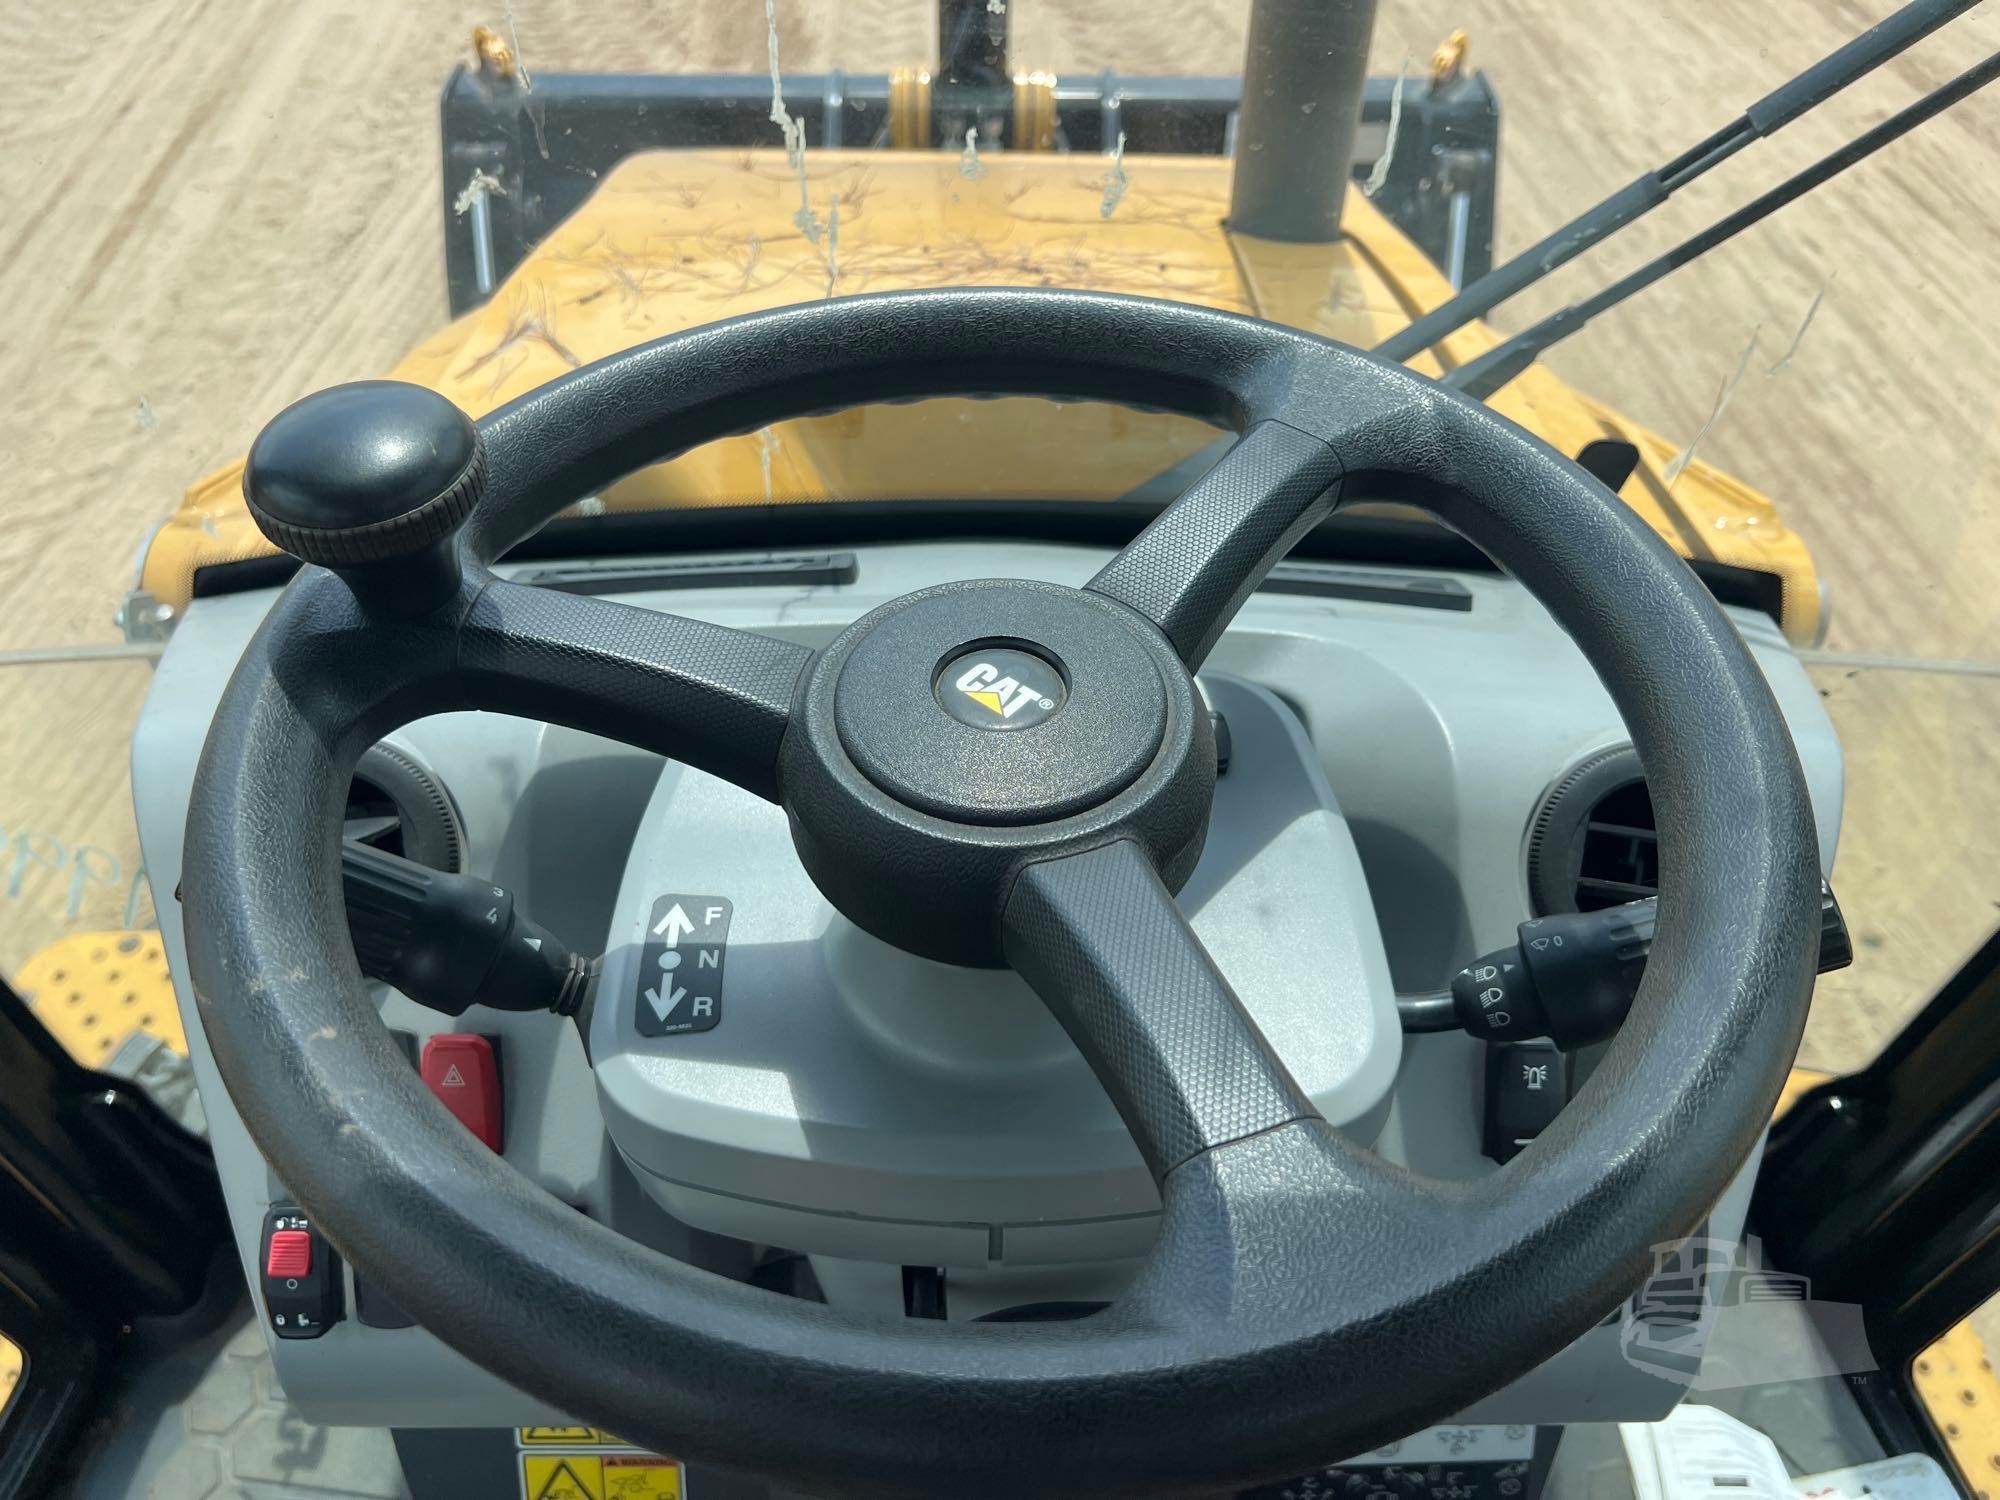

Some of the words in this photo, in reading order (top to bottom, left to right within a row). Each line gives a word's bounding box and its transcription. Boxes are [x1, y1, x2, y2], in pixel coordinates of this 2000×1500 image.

[485, 906, 498, 924] 4
[704, 906, 724, 926] F
[698, 949, 720, 969] N
[692, 996, 714, 1017] R
